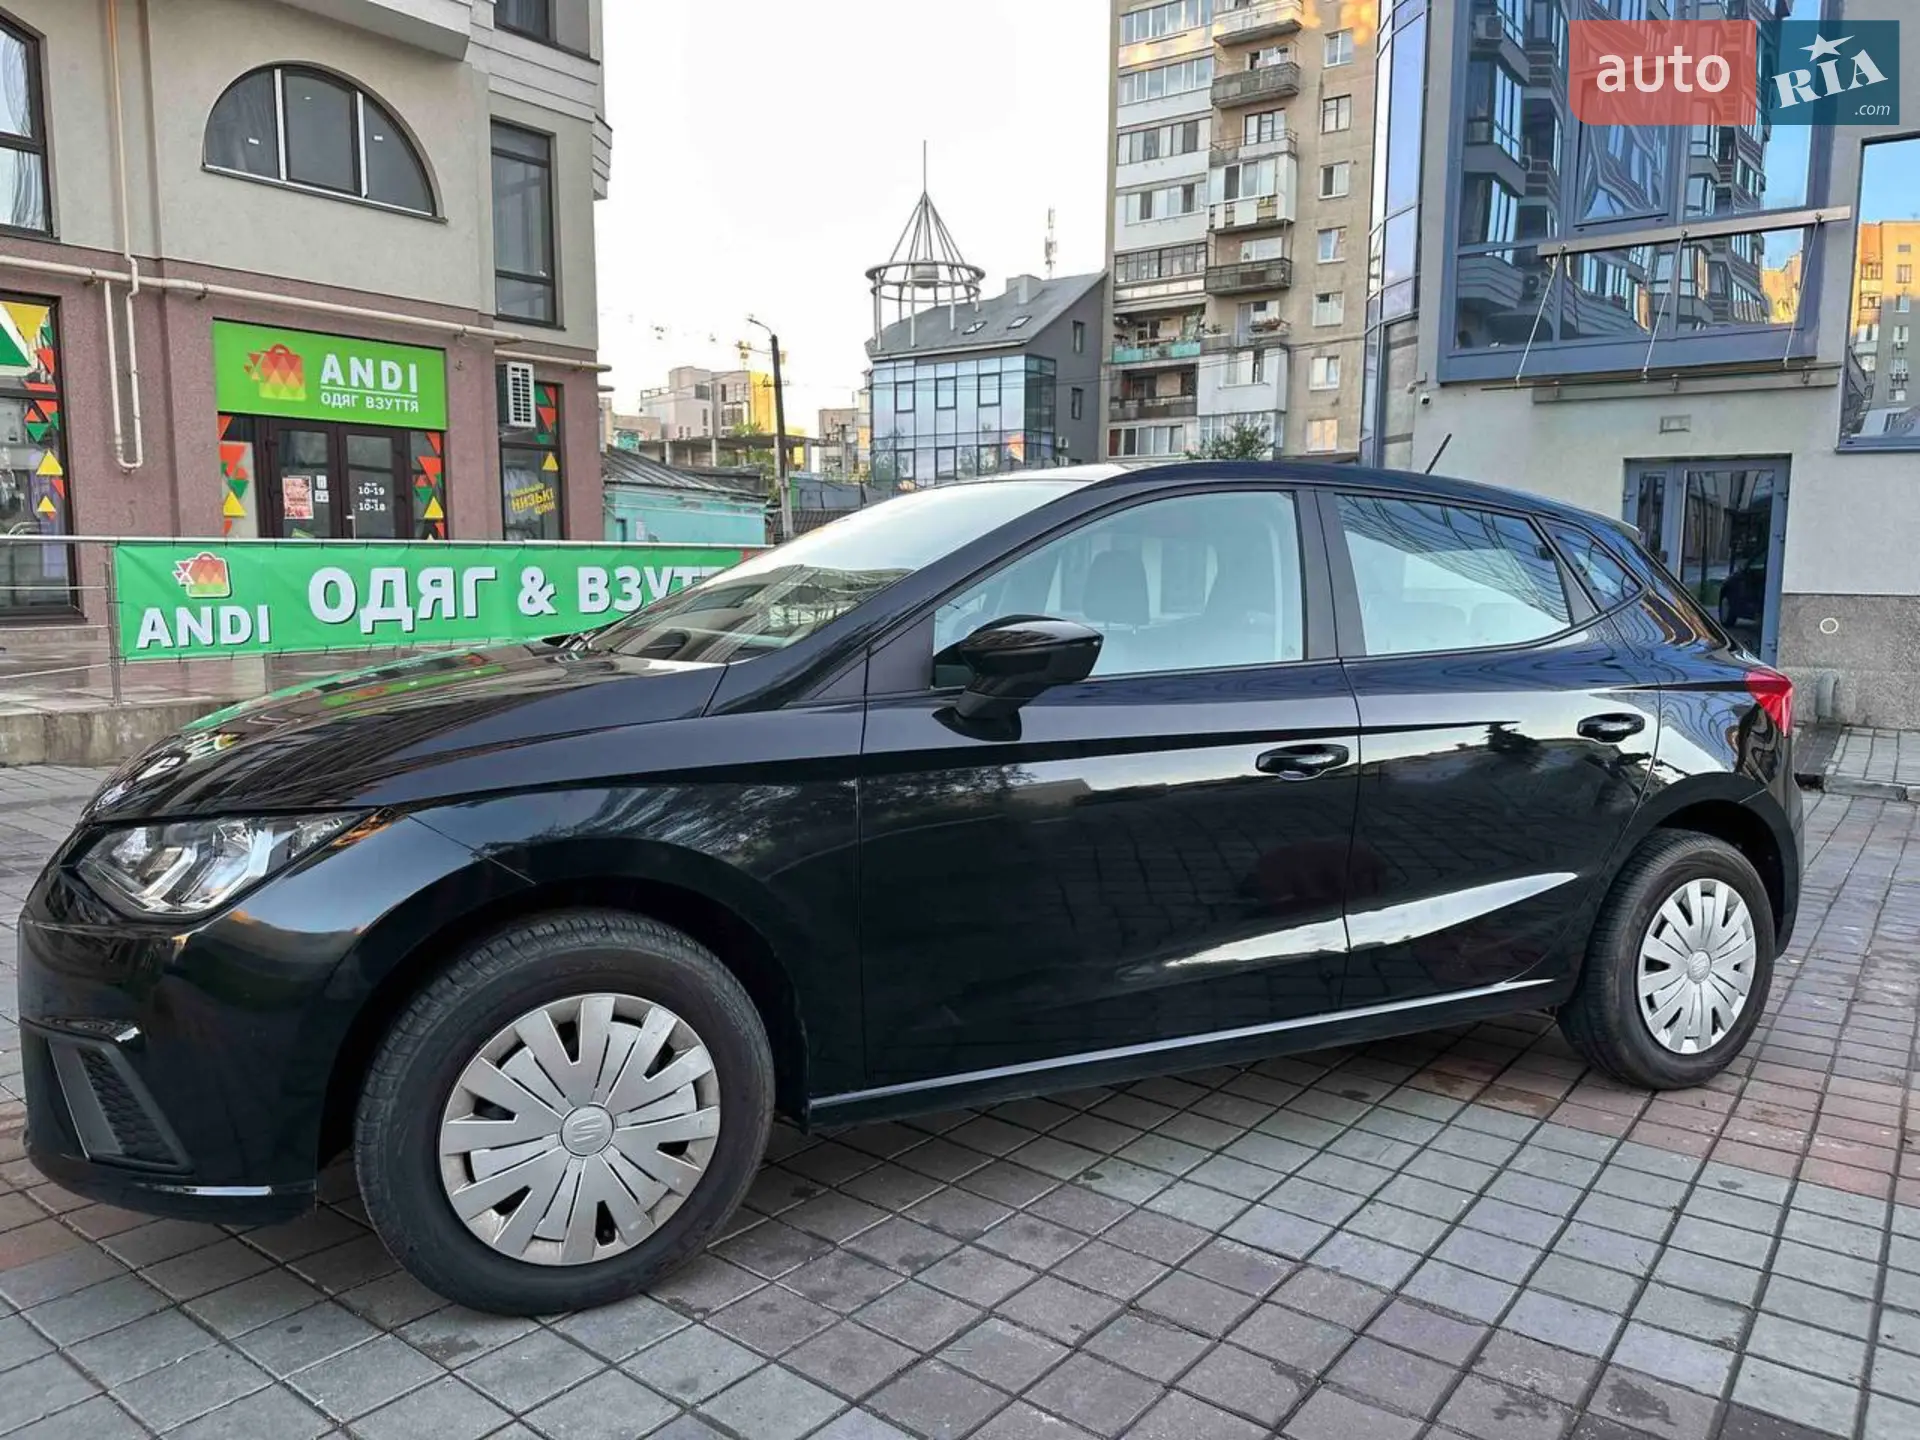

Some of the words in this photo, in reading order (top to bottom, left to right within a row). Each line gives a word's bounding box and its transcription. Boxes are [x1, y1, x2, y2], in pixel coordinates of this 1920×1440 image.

[320, 353, 418, 394] ANDI
[320, 392, 359, 409] ОДЯГ
[366, 396, 419, 413] ВЗУТТЯ
[358, 486, 385, 496] 10-19
[308, 566, 497, 634] ОДЯГ
[517, 566, 557, 616] &
[136, 604, 271, 649] ANDI
